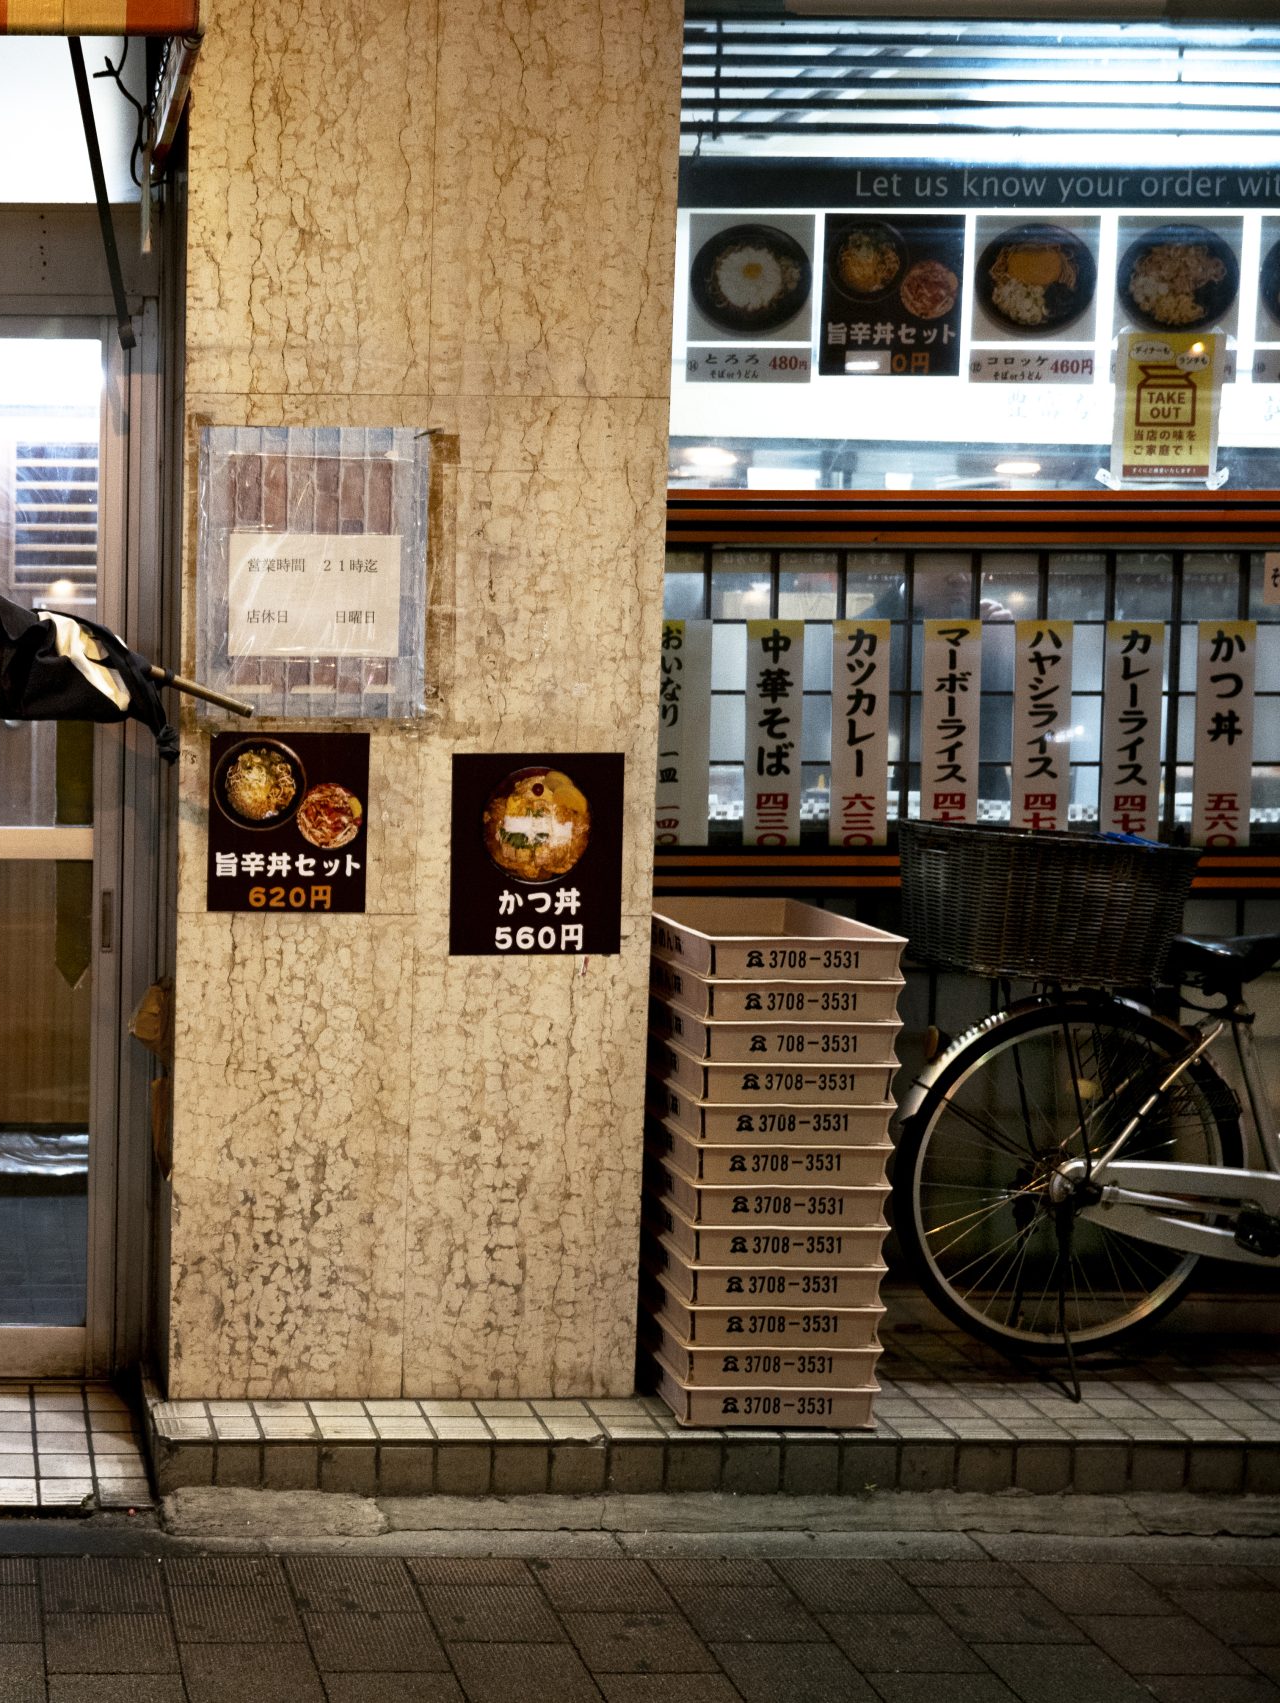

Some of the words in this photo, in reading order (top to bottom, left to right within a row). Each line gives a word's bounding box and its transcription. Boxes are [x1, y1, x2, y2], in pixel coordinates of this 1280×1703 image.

[856, 171, 901, 197] Let
[915, 175, 948, 197] us
[963, 171, 1048, 197] know
[1059, 175, 1129, 203] your
[1141, 171, 1227, 198] order
[827, 322, 957, 345] 旨辛丼セット
[705, 353, 760, 365] とろろ
[769, 355, 808, 371] 480円
[987, 355, 1049, 366] コロッケ
[1050, 357, 1094, 375] 460円
[1147, 391, 1186, 405] TAKE
[1149, 406, 1182, 419] OUT
[1134, 429, 1197, 442] 当店の味を
[247, 558, 305, 573] 営業時間
[247, 610, 288, 624] 店休日
[336, 610, 376, 624] 日曜日
[660, 626, 683, 727] おいなり
[1207, 630, 1246, 745] かつ丼
[756, 628, 795, 776] 中華そば
[846, 628, 878, 777] カツカレー
[934, 628, 972, 783] マーボーライス
[1024, 629, 1063, 779] ハヤシライス
[1114, 629, 1152, 786] カレーライス
[659, 751, 679, 783] 一皿
[215, 852, 361, 878] 旨辛丼セット
[249, 886, 332, 910] 620円
[498, 887, 581, 916] かつ丼
[494, 923, 584, 951] 560円
[769, 951, 859, 969] 3708-3531
[767, 993, 857, 1010] 3708-3531
[777, 1035, 857, 1052] 708-3531
[765, 1074, 855, 1091] 3708-3531
[759, 1114, 849, 1131] 3708-3531
[752, 1154, 841, 1171] 3708-3531
[754, 1196, 843, 1215] 3708-3531
[752, 1236, 842, 1254] 3708-3531
[748, 1276, 838, 1294] 3708-3531
[749, 1315, 838, 1333] 3708-3531
[744, 1355, 833, 1373] 3708-3531
[744, 1396, 833, 1415] 3708-3531
